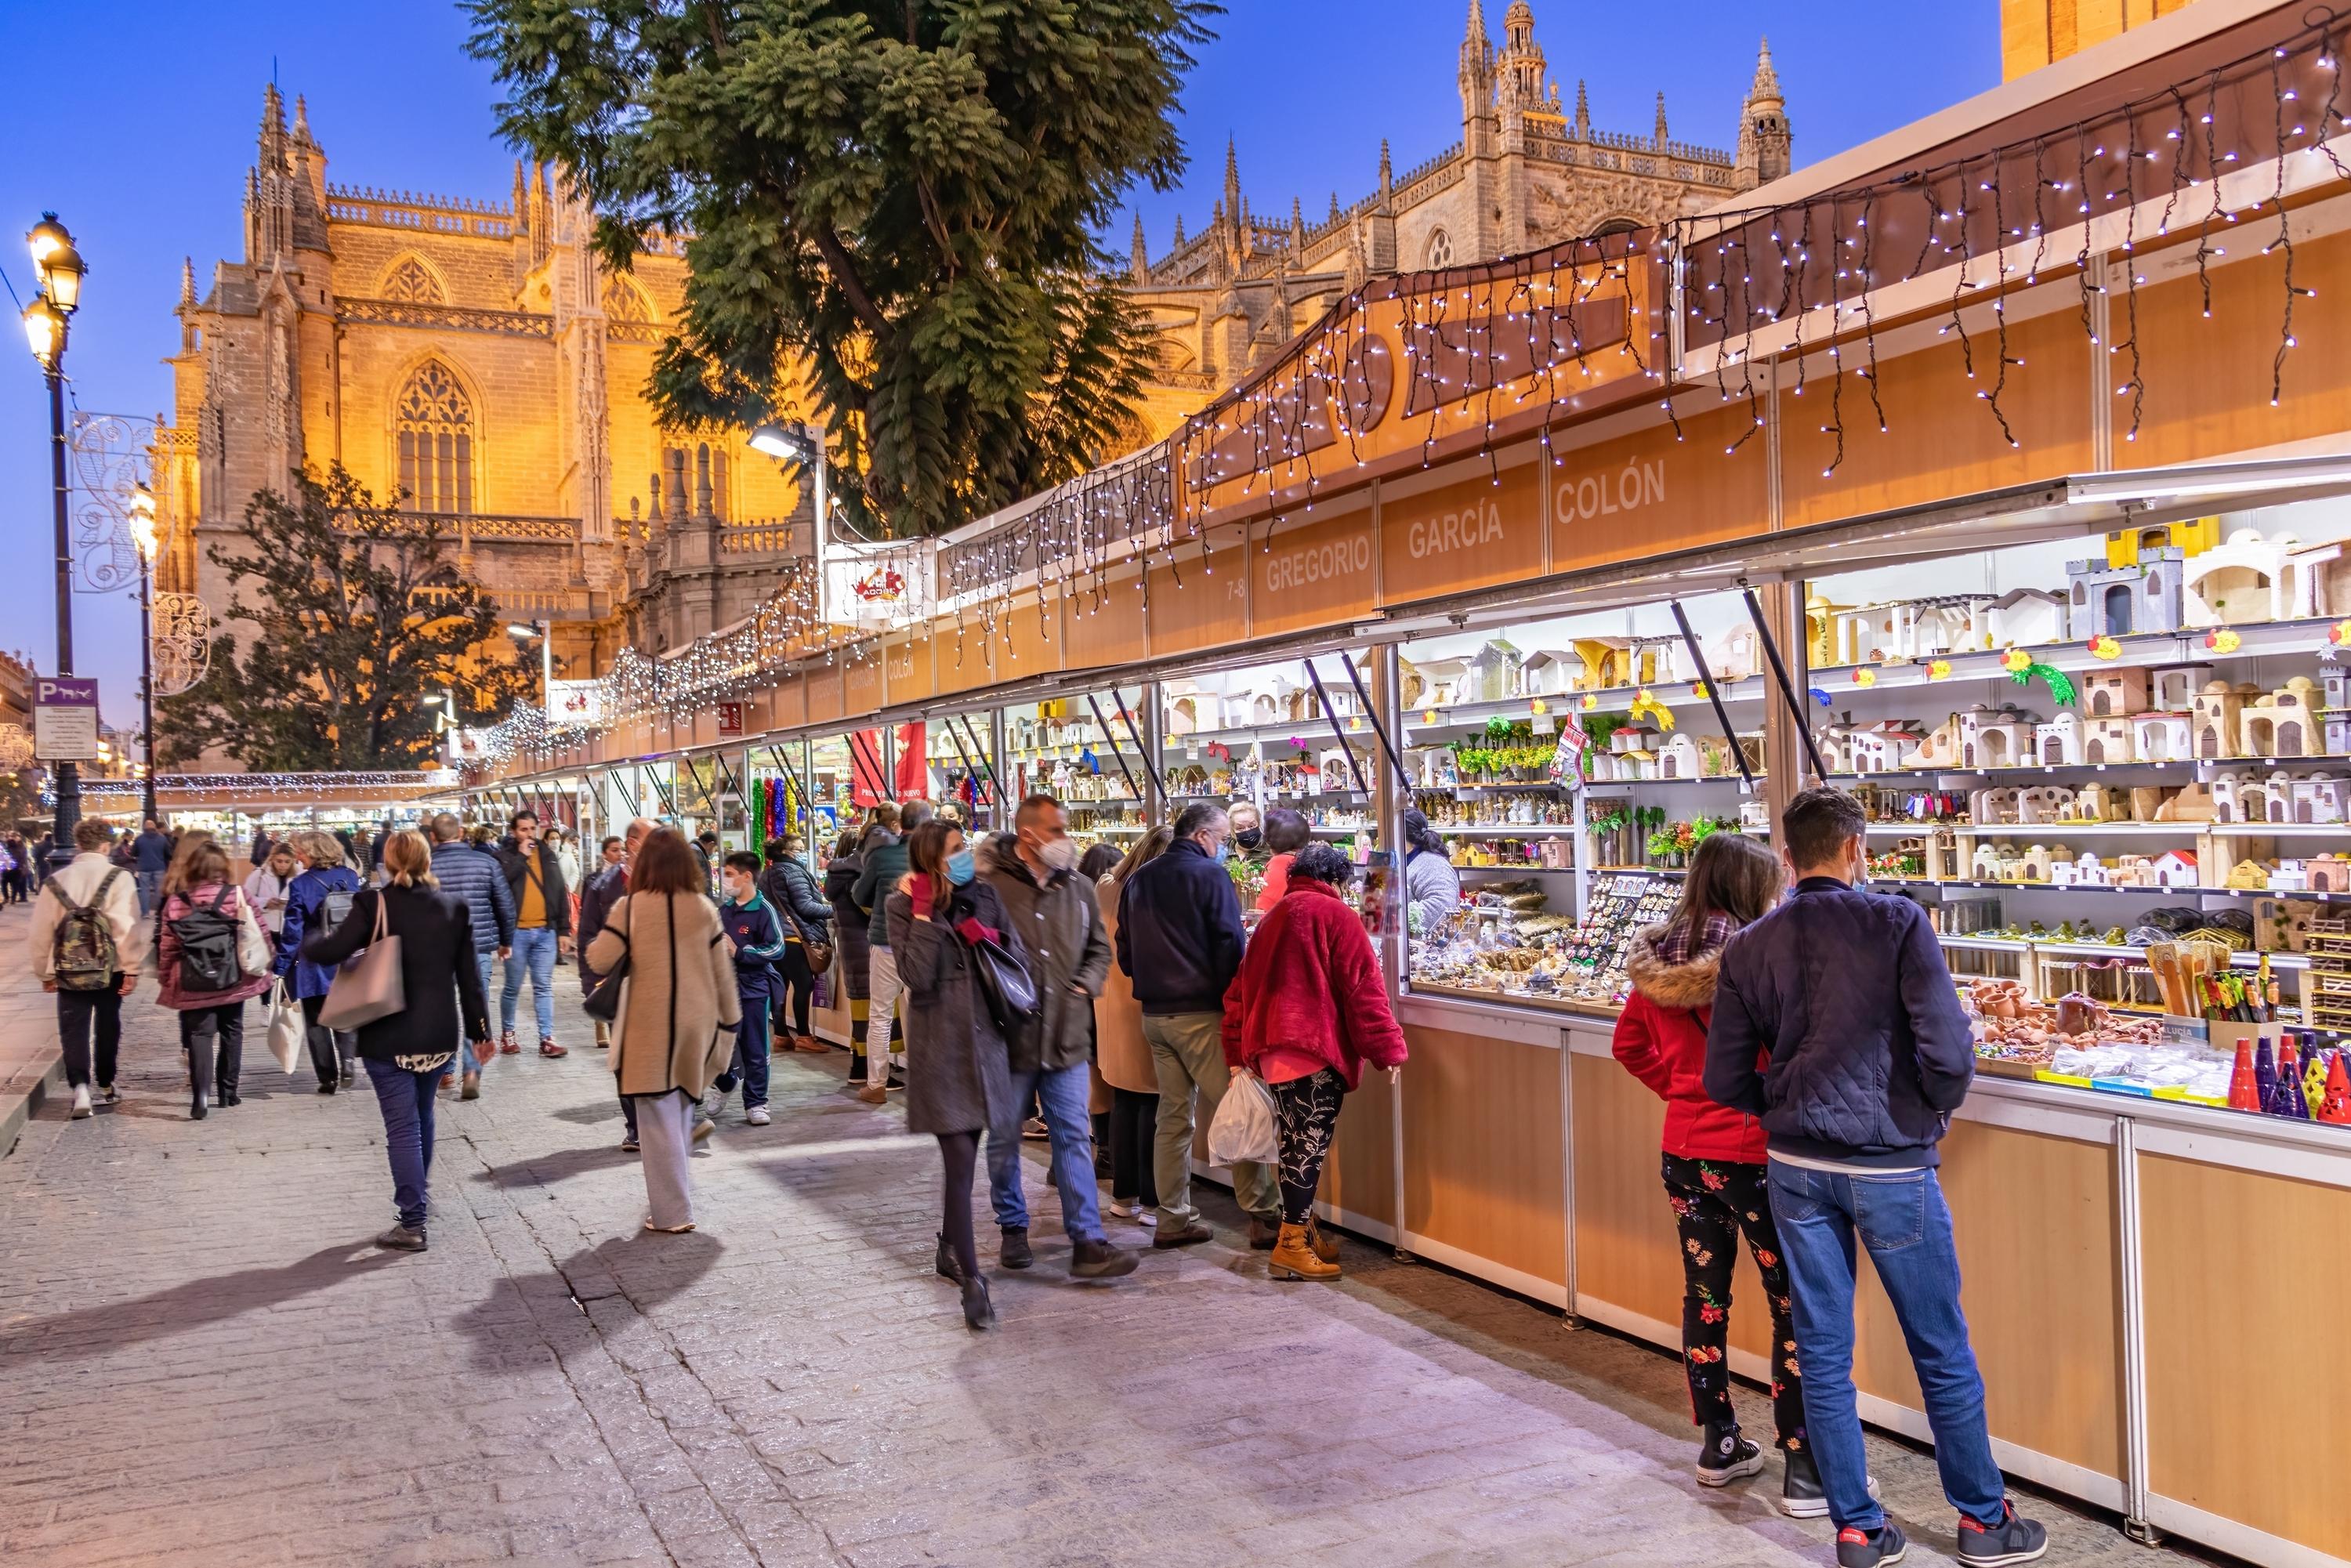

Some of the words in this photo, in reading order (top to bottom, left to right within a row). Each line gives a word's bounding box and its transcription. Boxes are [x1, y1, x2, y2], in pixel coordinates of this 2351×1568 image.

[1226, 578, 1244, 600] 7-8
[1267, 536, 1369, 592] GREGORIO
[1409, 497, 1504, 559] GARCÍA
[1556, 455, 1665, 524] COLÓN
[39, 682, 57, 702] P
[904, 789, 921, 798] NUEVO
